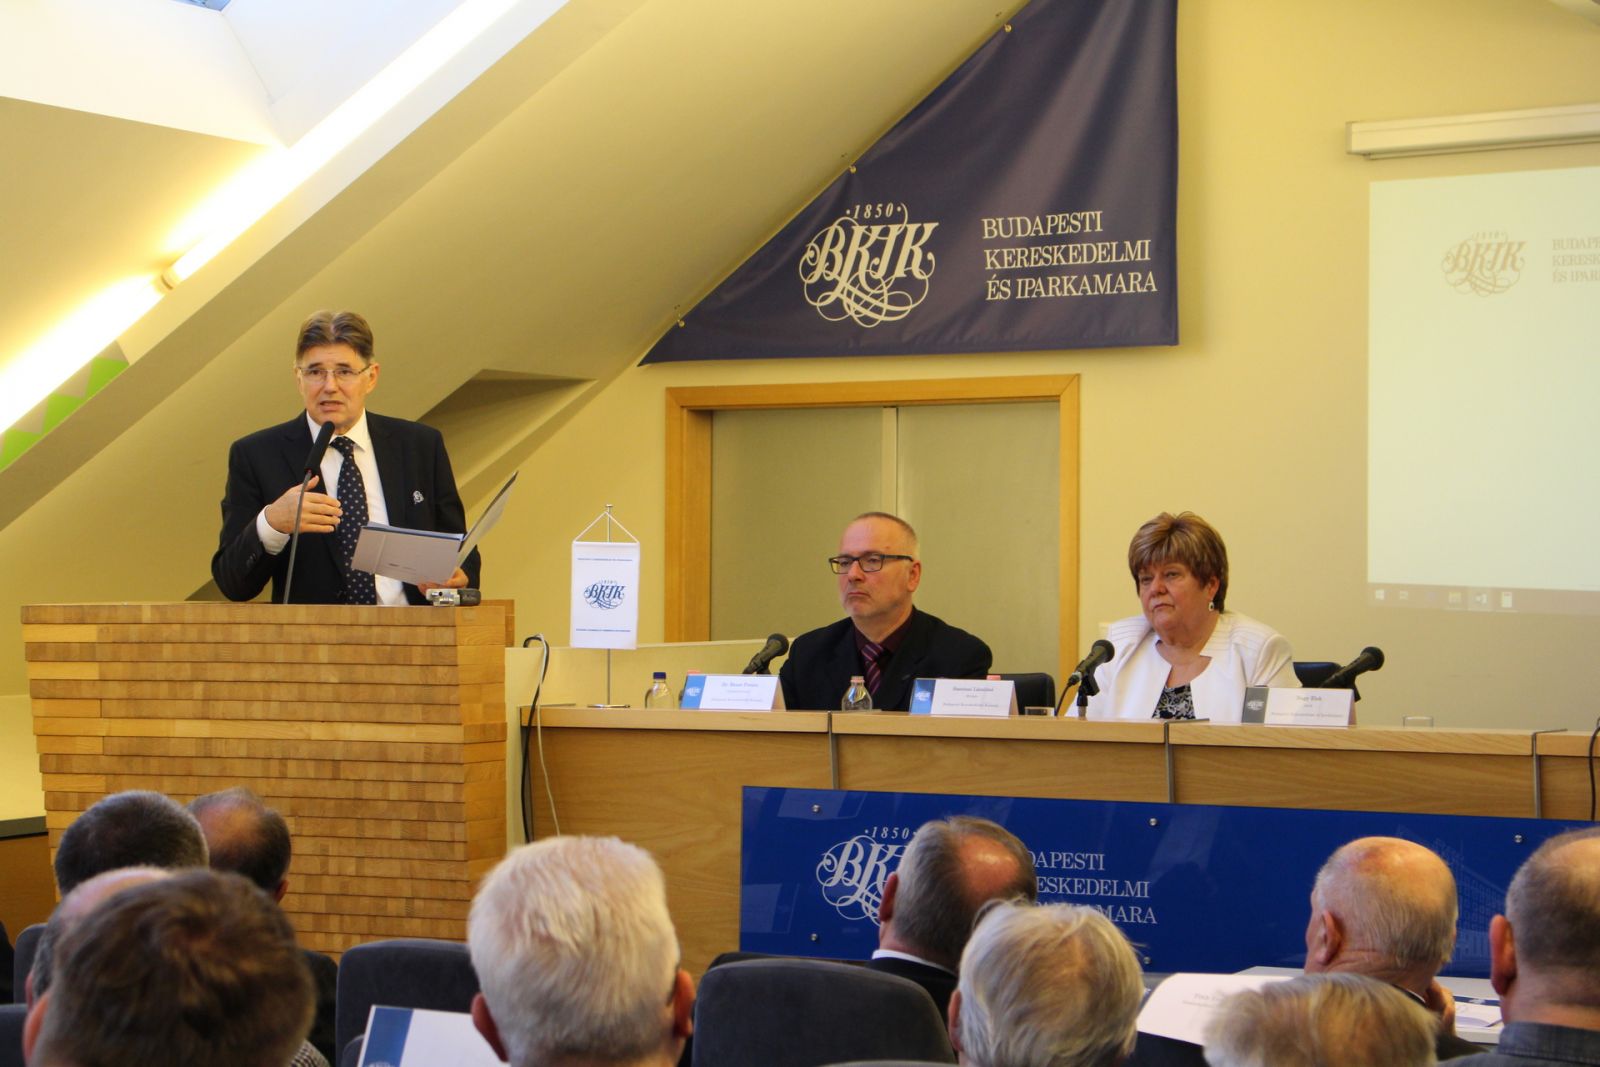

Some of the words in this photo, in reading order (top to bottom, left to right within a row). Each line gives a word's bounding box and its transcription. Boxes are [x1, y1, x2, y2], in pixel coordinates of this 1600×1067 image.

[853, 203, 894, 219] 1850
[981, 211, 1103, 239] BUDAPESTI
[984, 240, 1151, 270] KERESKEDELMI
[986, 274, 1011, 300] ÉS
[1016, 271, 1158, 299] IPARKAMARA
[872, 827, 909, 839] 1850
[1036, 876, 1150, 898] ESKEDELMI
